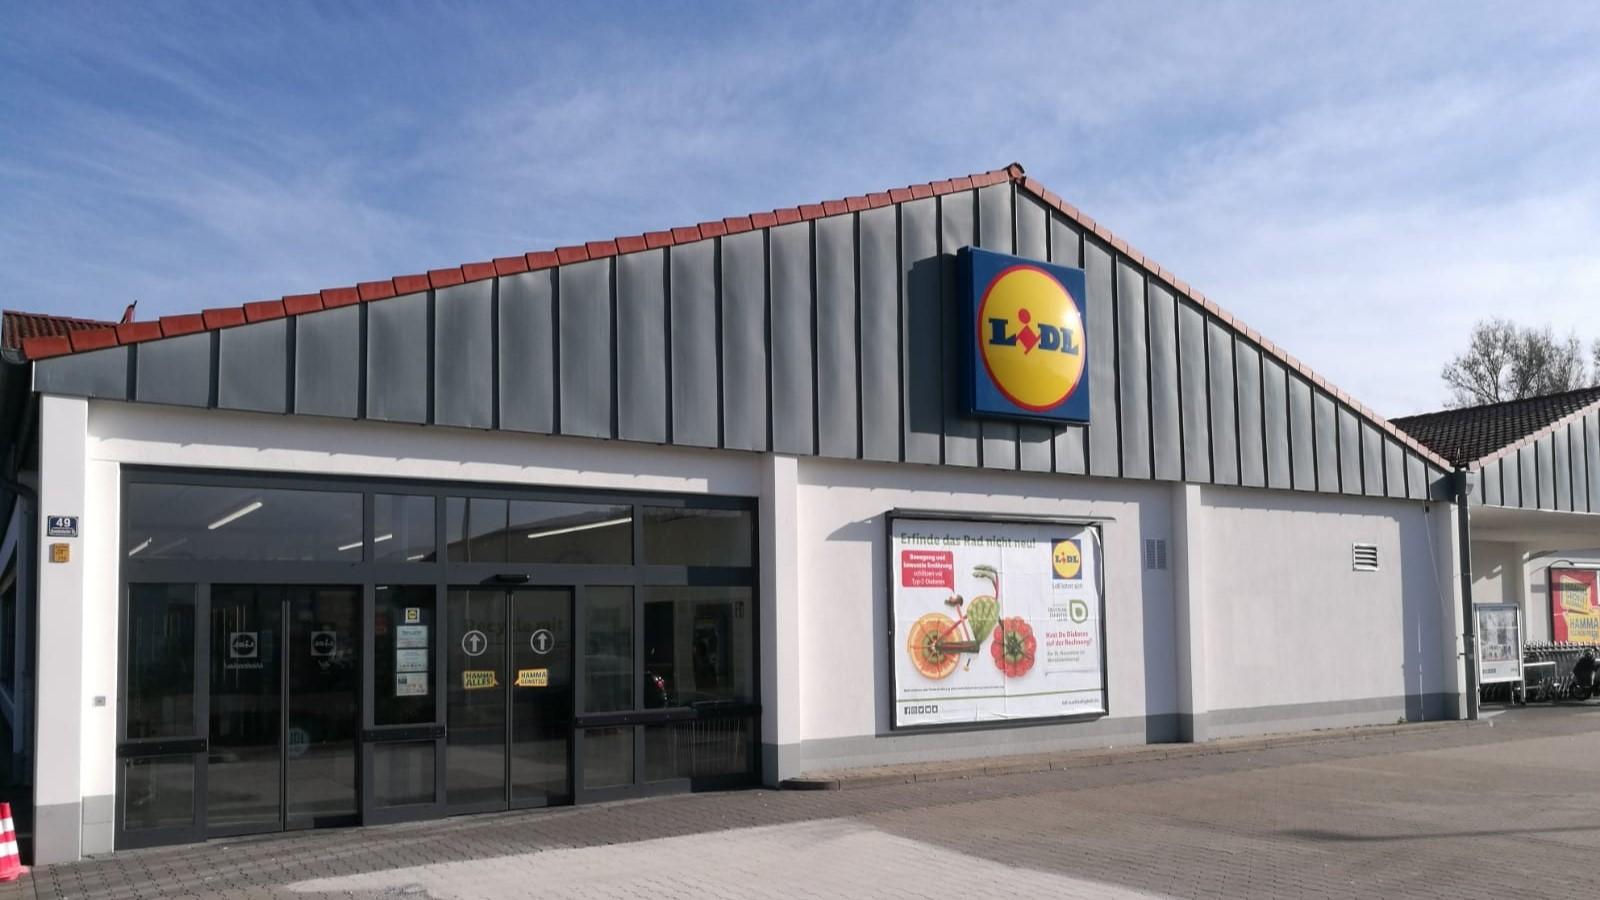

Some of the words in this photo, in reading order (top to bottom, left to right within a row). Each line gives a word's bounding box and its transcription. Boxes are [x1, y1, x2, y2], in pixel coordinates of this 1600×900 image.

[988, 308, 1079, 356] LIDL
[55, 517, 71, 527] 49
[901, 532, 940, 545] Erfinde
[943, 534, 960, 546] das
[963, 535, 983, 547] Rad
[986, 536, 1012, 549] nicht
[1014, 538, 1036, 549] neu!
[1067, 630, 1089, 638] Diabetes
[465, 671, 494, 680] HAMMA
[520, 670, 547, 679] HAMMA
